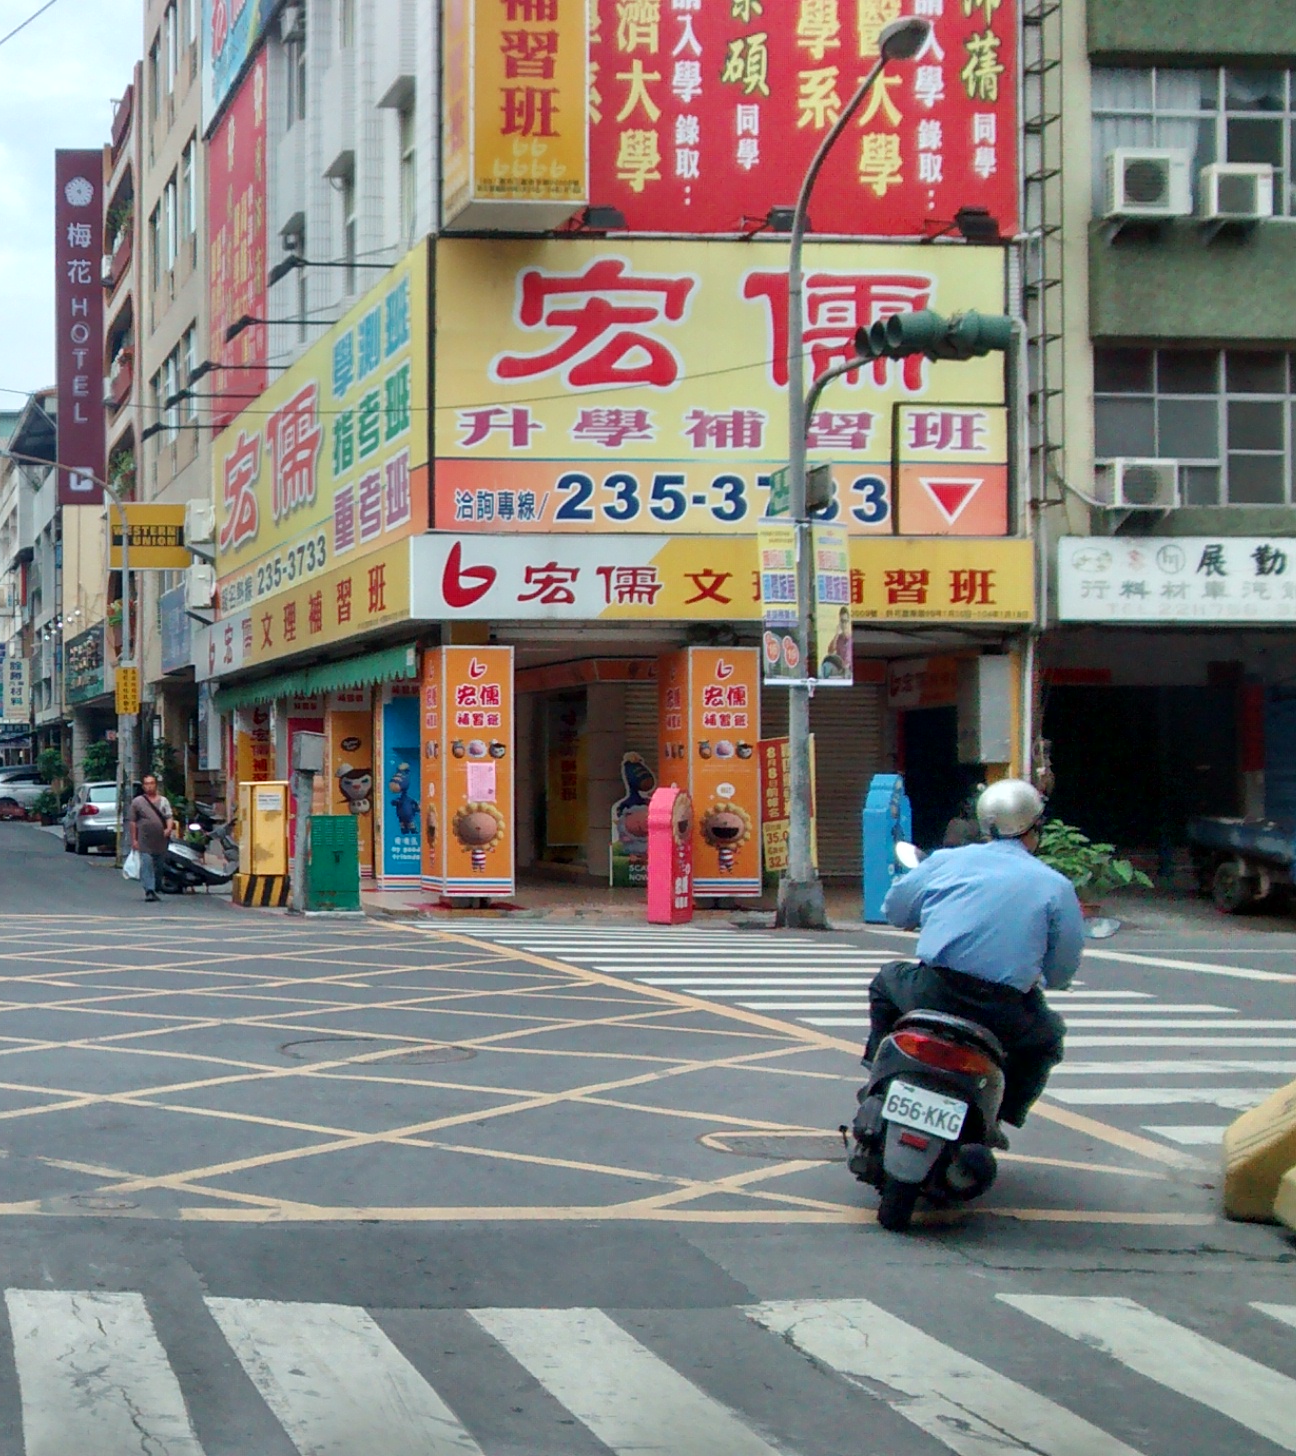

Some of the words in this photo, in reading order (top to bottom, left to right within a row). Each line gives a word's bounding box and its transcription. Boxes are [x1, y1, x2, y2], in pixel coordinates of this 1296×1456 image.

[736, 103, 760, 171] 同學
[972, 112, 997, 179] 同學
[67, 222, 92, 284] 梅花
[332, 274, 410, 398] 學測班
[496, 259, 931, 392] 宏儒
[71, 298, 90, 424] HOTEL
[332, 364, 410, 480] 指考班
[457, 408, 987, 452] 升學補習班
[220, 381, 322, 553] 宏儒
[333, 451, 410, 556] 重考班
[133, 536, 176, 546] UNION
[257, 534, 326, 597] 235-3733
[457, 685, 500, 706] 宏儒
[704, 686, 747, 707] 宏儒
[887, 1094, 961, 1133] 656-KKG
